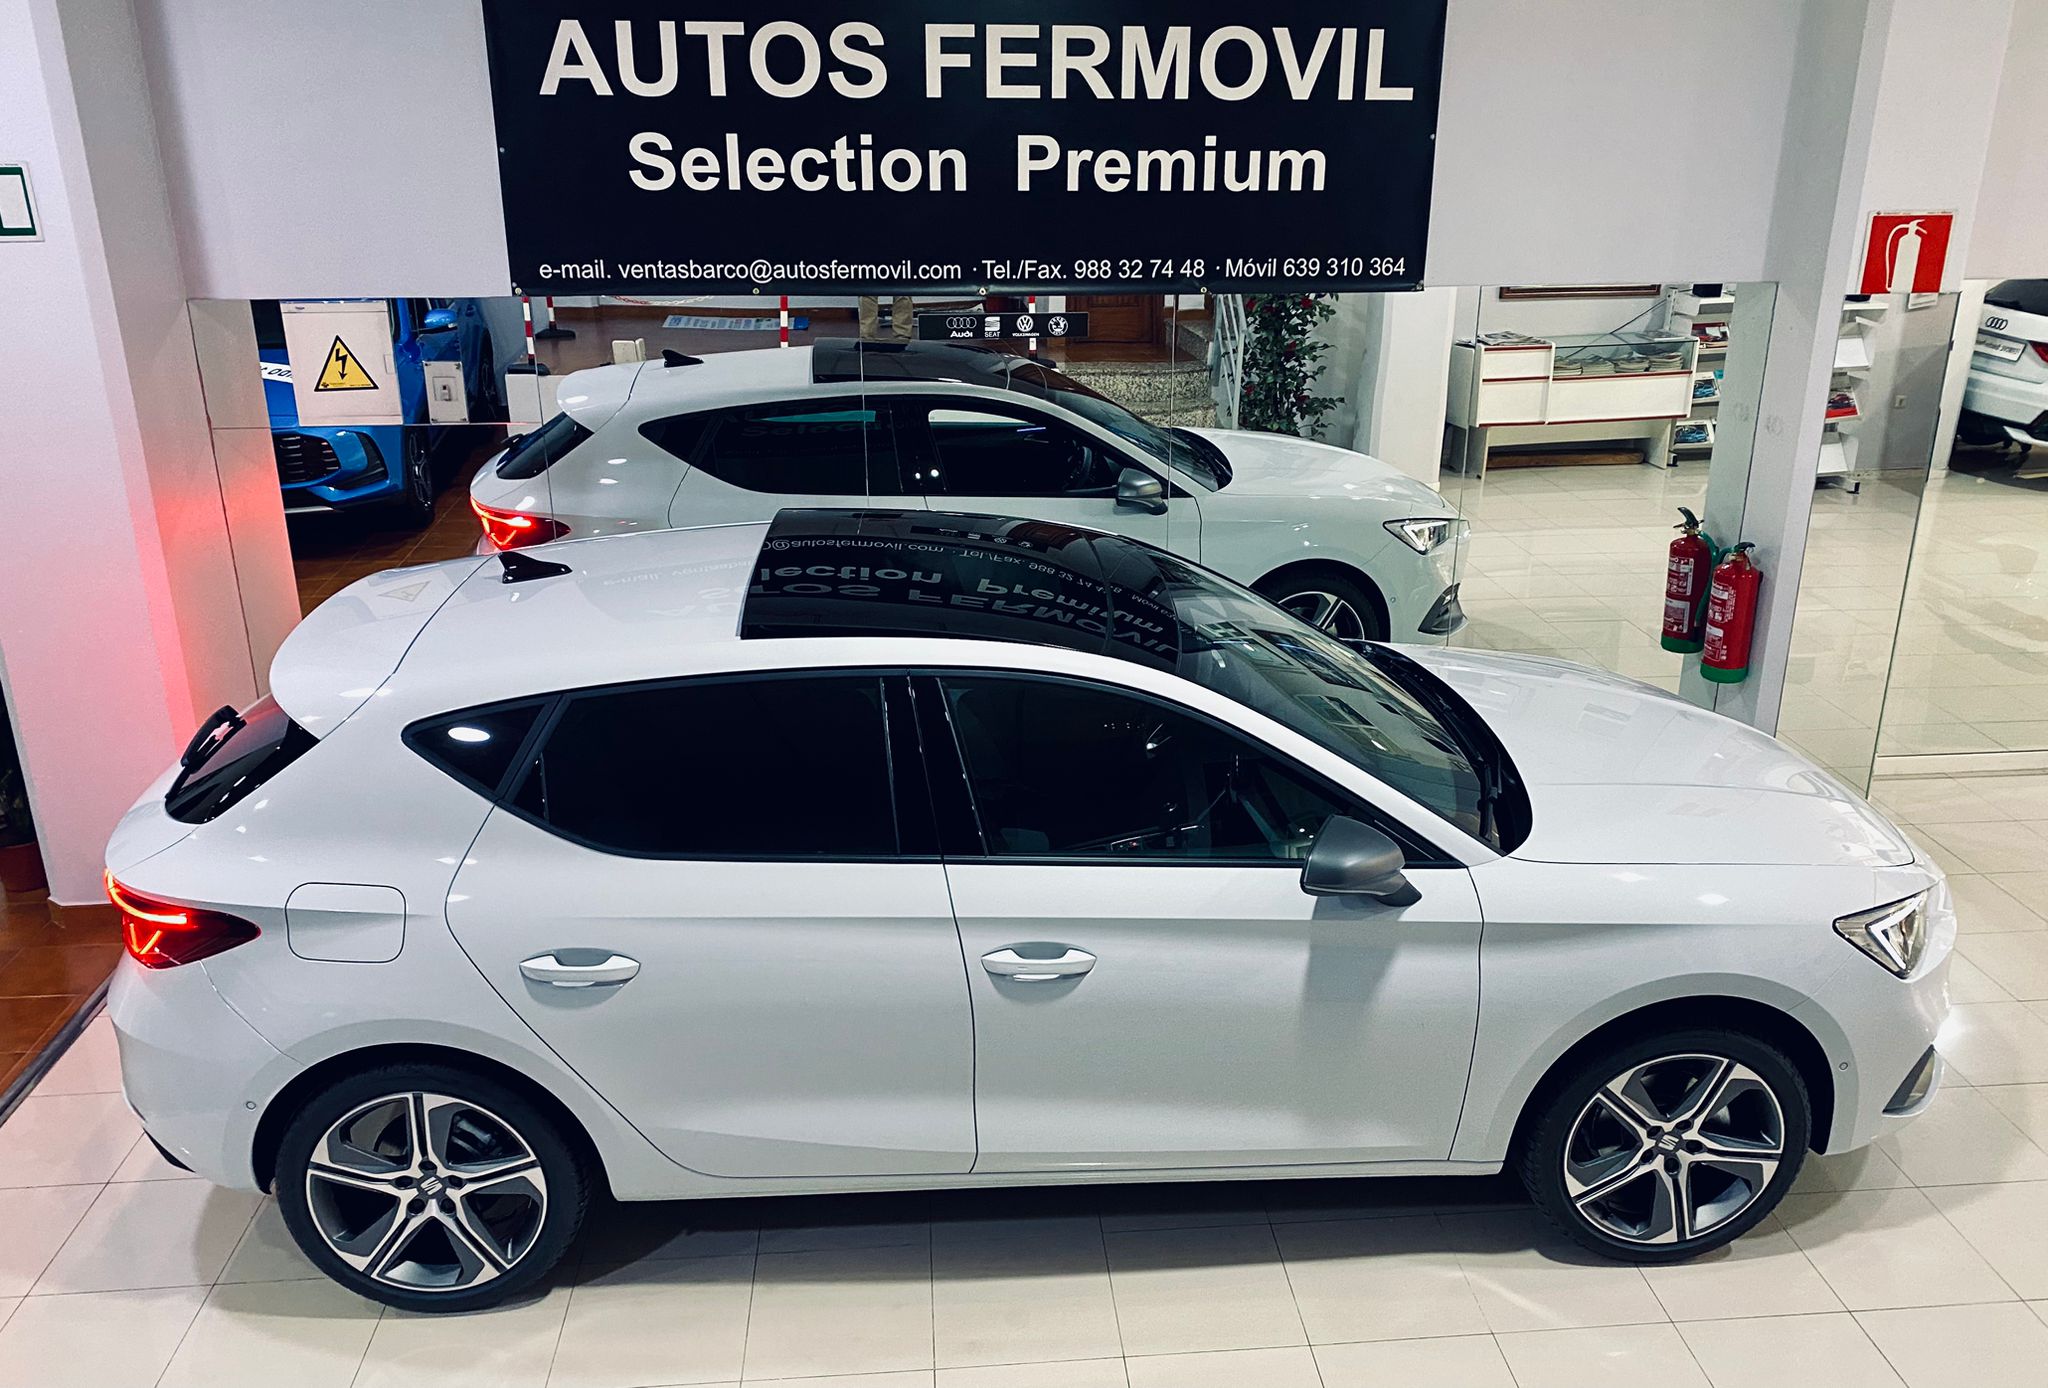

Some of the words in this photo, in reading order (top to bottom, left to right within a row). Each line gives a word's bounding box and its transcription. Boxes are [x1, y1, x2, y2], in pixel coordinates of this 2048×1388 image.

[540, 20, 887, 98] AUTOS
[925, 24, 1413, 101] FERMOVIL
[629, 132, 967, 192] Selection
[1018, 135, 1326, 192] Premium
[540, 259, 611, 279] e-mail.
[618, 260, 961, 283] ventasbarco@autosfermovil.com
[1075, 260, 1111, 279] 988
[1119, 260, 1142, 279] 32
[1150, 259, 1173, 278] 74
[1180, 259, 1204, 278] 48
[1284, 258, 1320, 277] 639
[1327, 258, 1363, 277] 310
[1370, 257, 1406, 277] 364
[950, 330, 973, 338] Audi
